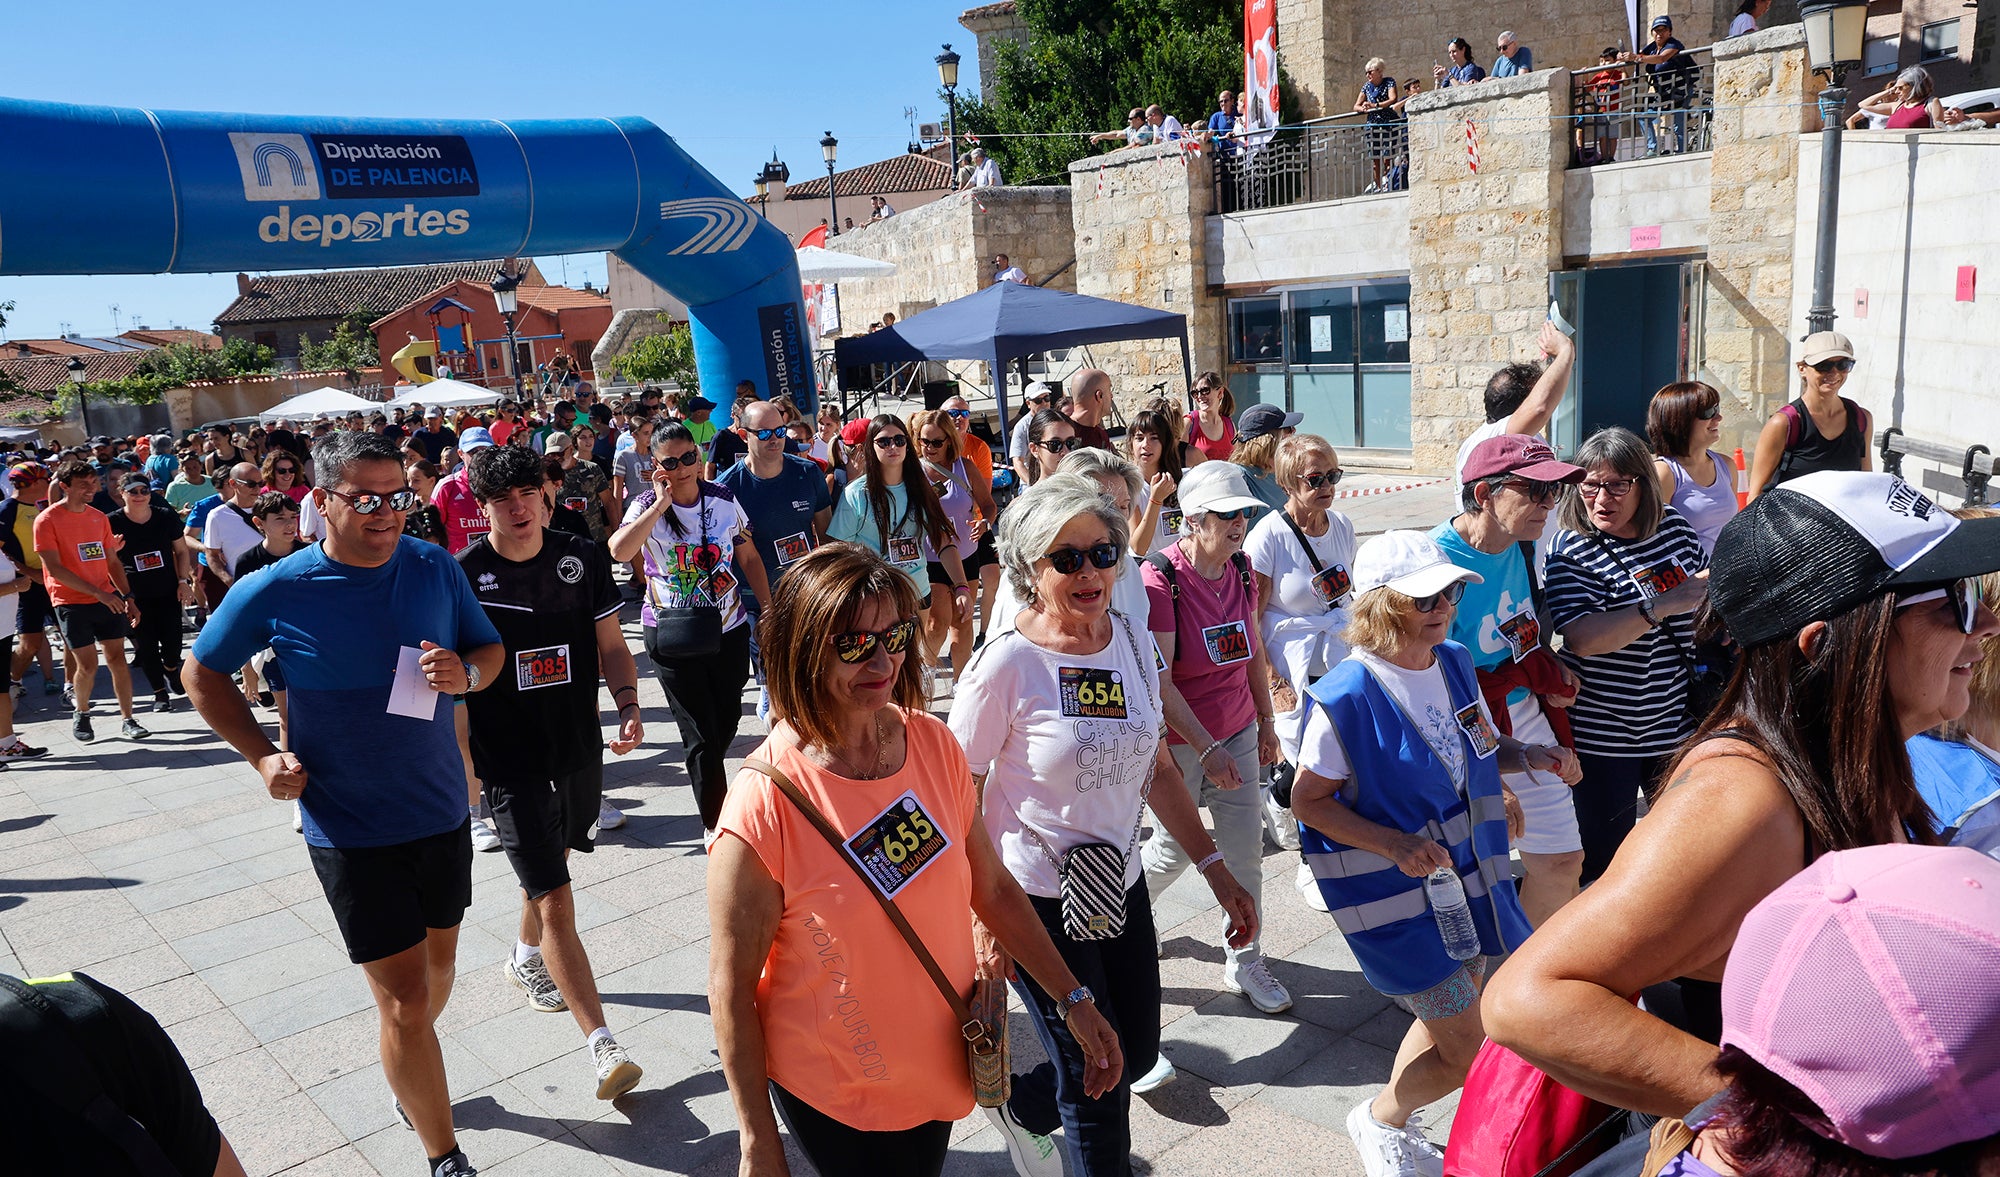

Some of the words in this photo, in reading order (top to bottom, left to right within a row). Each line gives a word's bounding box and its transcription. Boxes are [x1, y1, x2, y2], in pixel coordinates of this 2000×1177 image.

[322, 142, 441, 162] Diputación
[331, 168, 363, 186] DE
[368, 167, 474, 186] PALENCIA
[258, 203, 470, 247] deportes
[784, 306, 801, 385] PALENCIA
[769, 329, 793, 400] putación
[1889, 484, 1917, 517] SONIC
[86, 547, 102, 556] 552
[785, 540, 807, 555] 271
[901, 544, 916, 555] 915
[1321, 571, 1348, 594] 019
[1652, 566, 1688, 593] 388
[1218, 632, 1247, 653] 070
[532, 656, 567, 677] 085
[1078, 681, 1124, 706] 654
[1080, 705, 1127, 717] VILLALOBÓN
[883, 810, 933, 863] 655
[898, 834, 944, 876] VILLALOBÓN
[800, 917, 845, 968] MOVE
